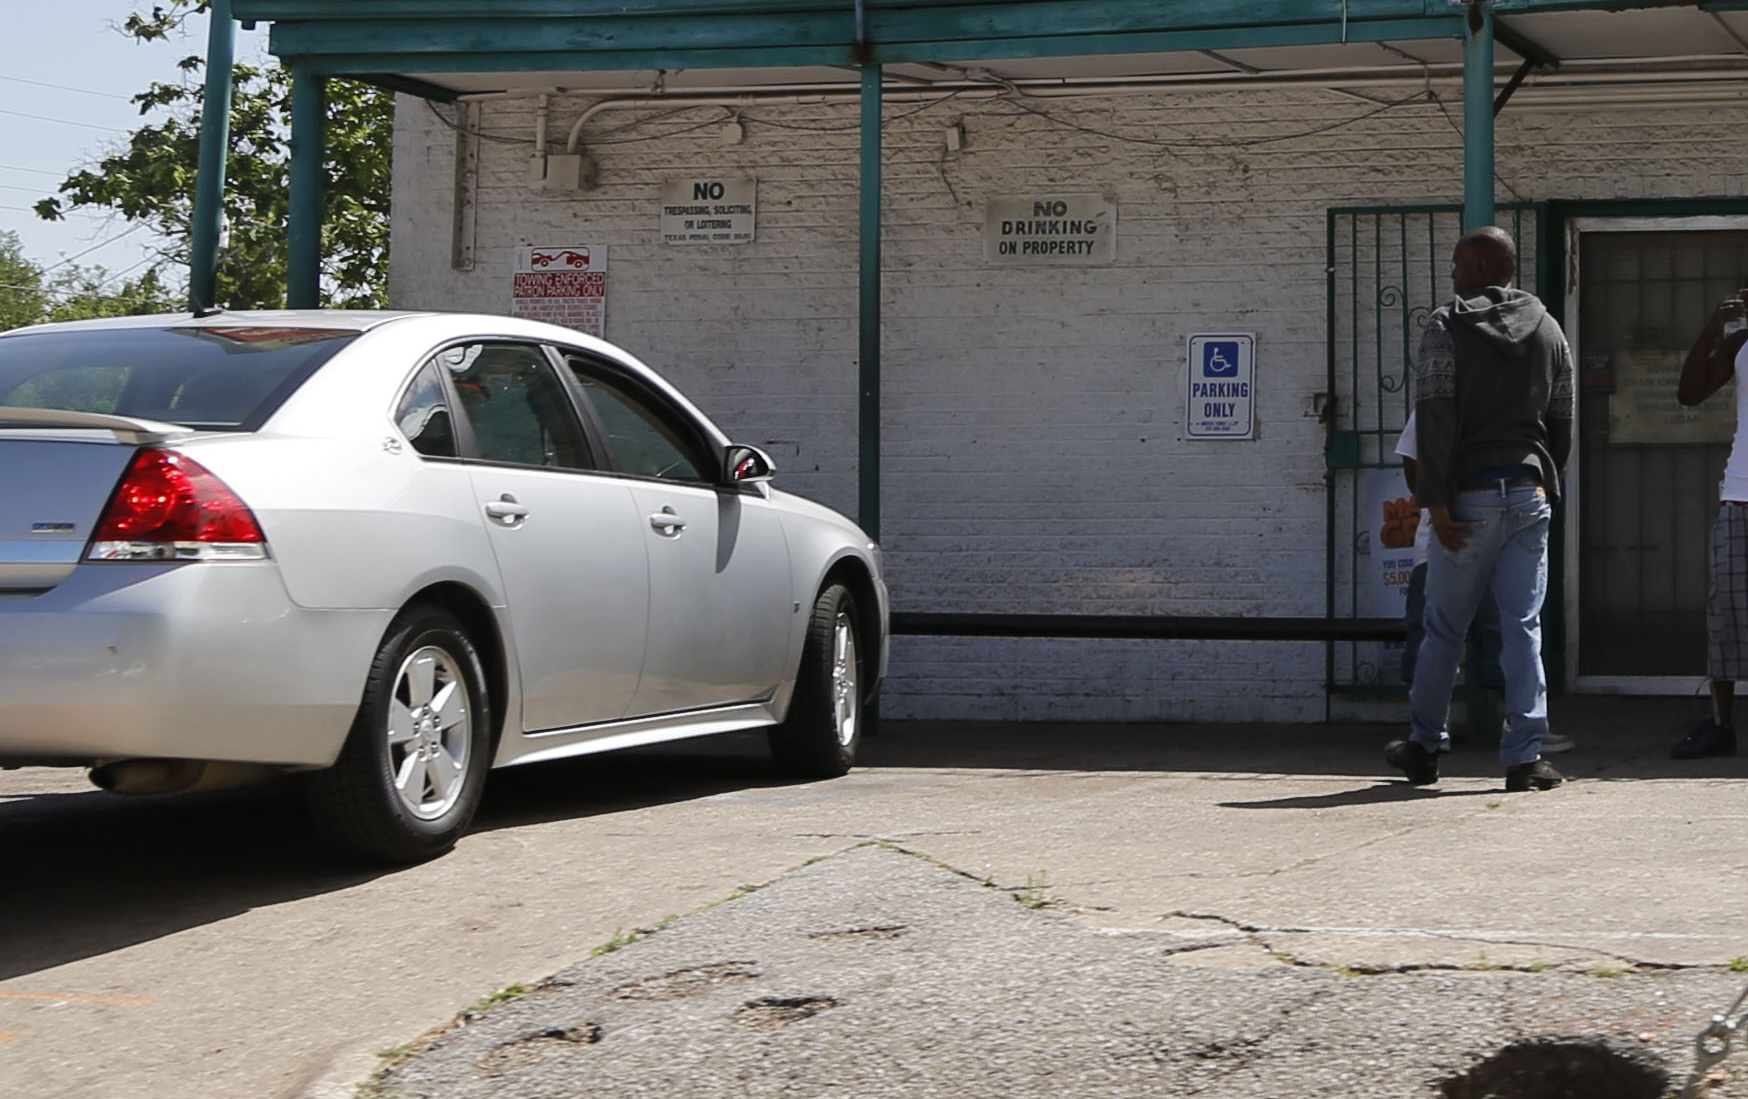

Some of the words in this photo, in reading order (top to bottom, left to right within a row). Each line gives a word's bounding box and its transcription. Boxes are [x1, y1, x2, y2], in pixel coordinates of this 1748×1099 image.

[694, 182, 725, 200] NO
[1033, 201, 1067, 217] NO
[684, 220, 694, 230] OR
[697, 219, 731, 229] LOITERING
[1001, 220, 1097, 235] DRINKING
[999, 241, 1017, 255] ON
[1023, 240, 1094, 255] PROPERTY
[515, 274, 552, 286] TOWING
[555, 273, 604, 285] ENFORCED
[514, 286, 545, 297] PATRON
[546, 286, 580, 297] PARKING
[582, 285, 603, 297] ONLY
[1192, 382, 1249, 398] PARKING
[1204, 403, 1236, 418] ONLY
